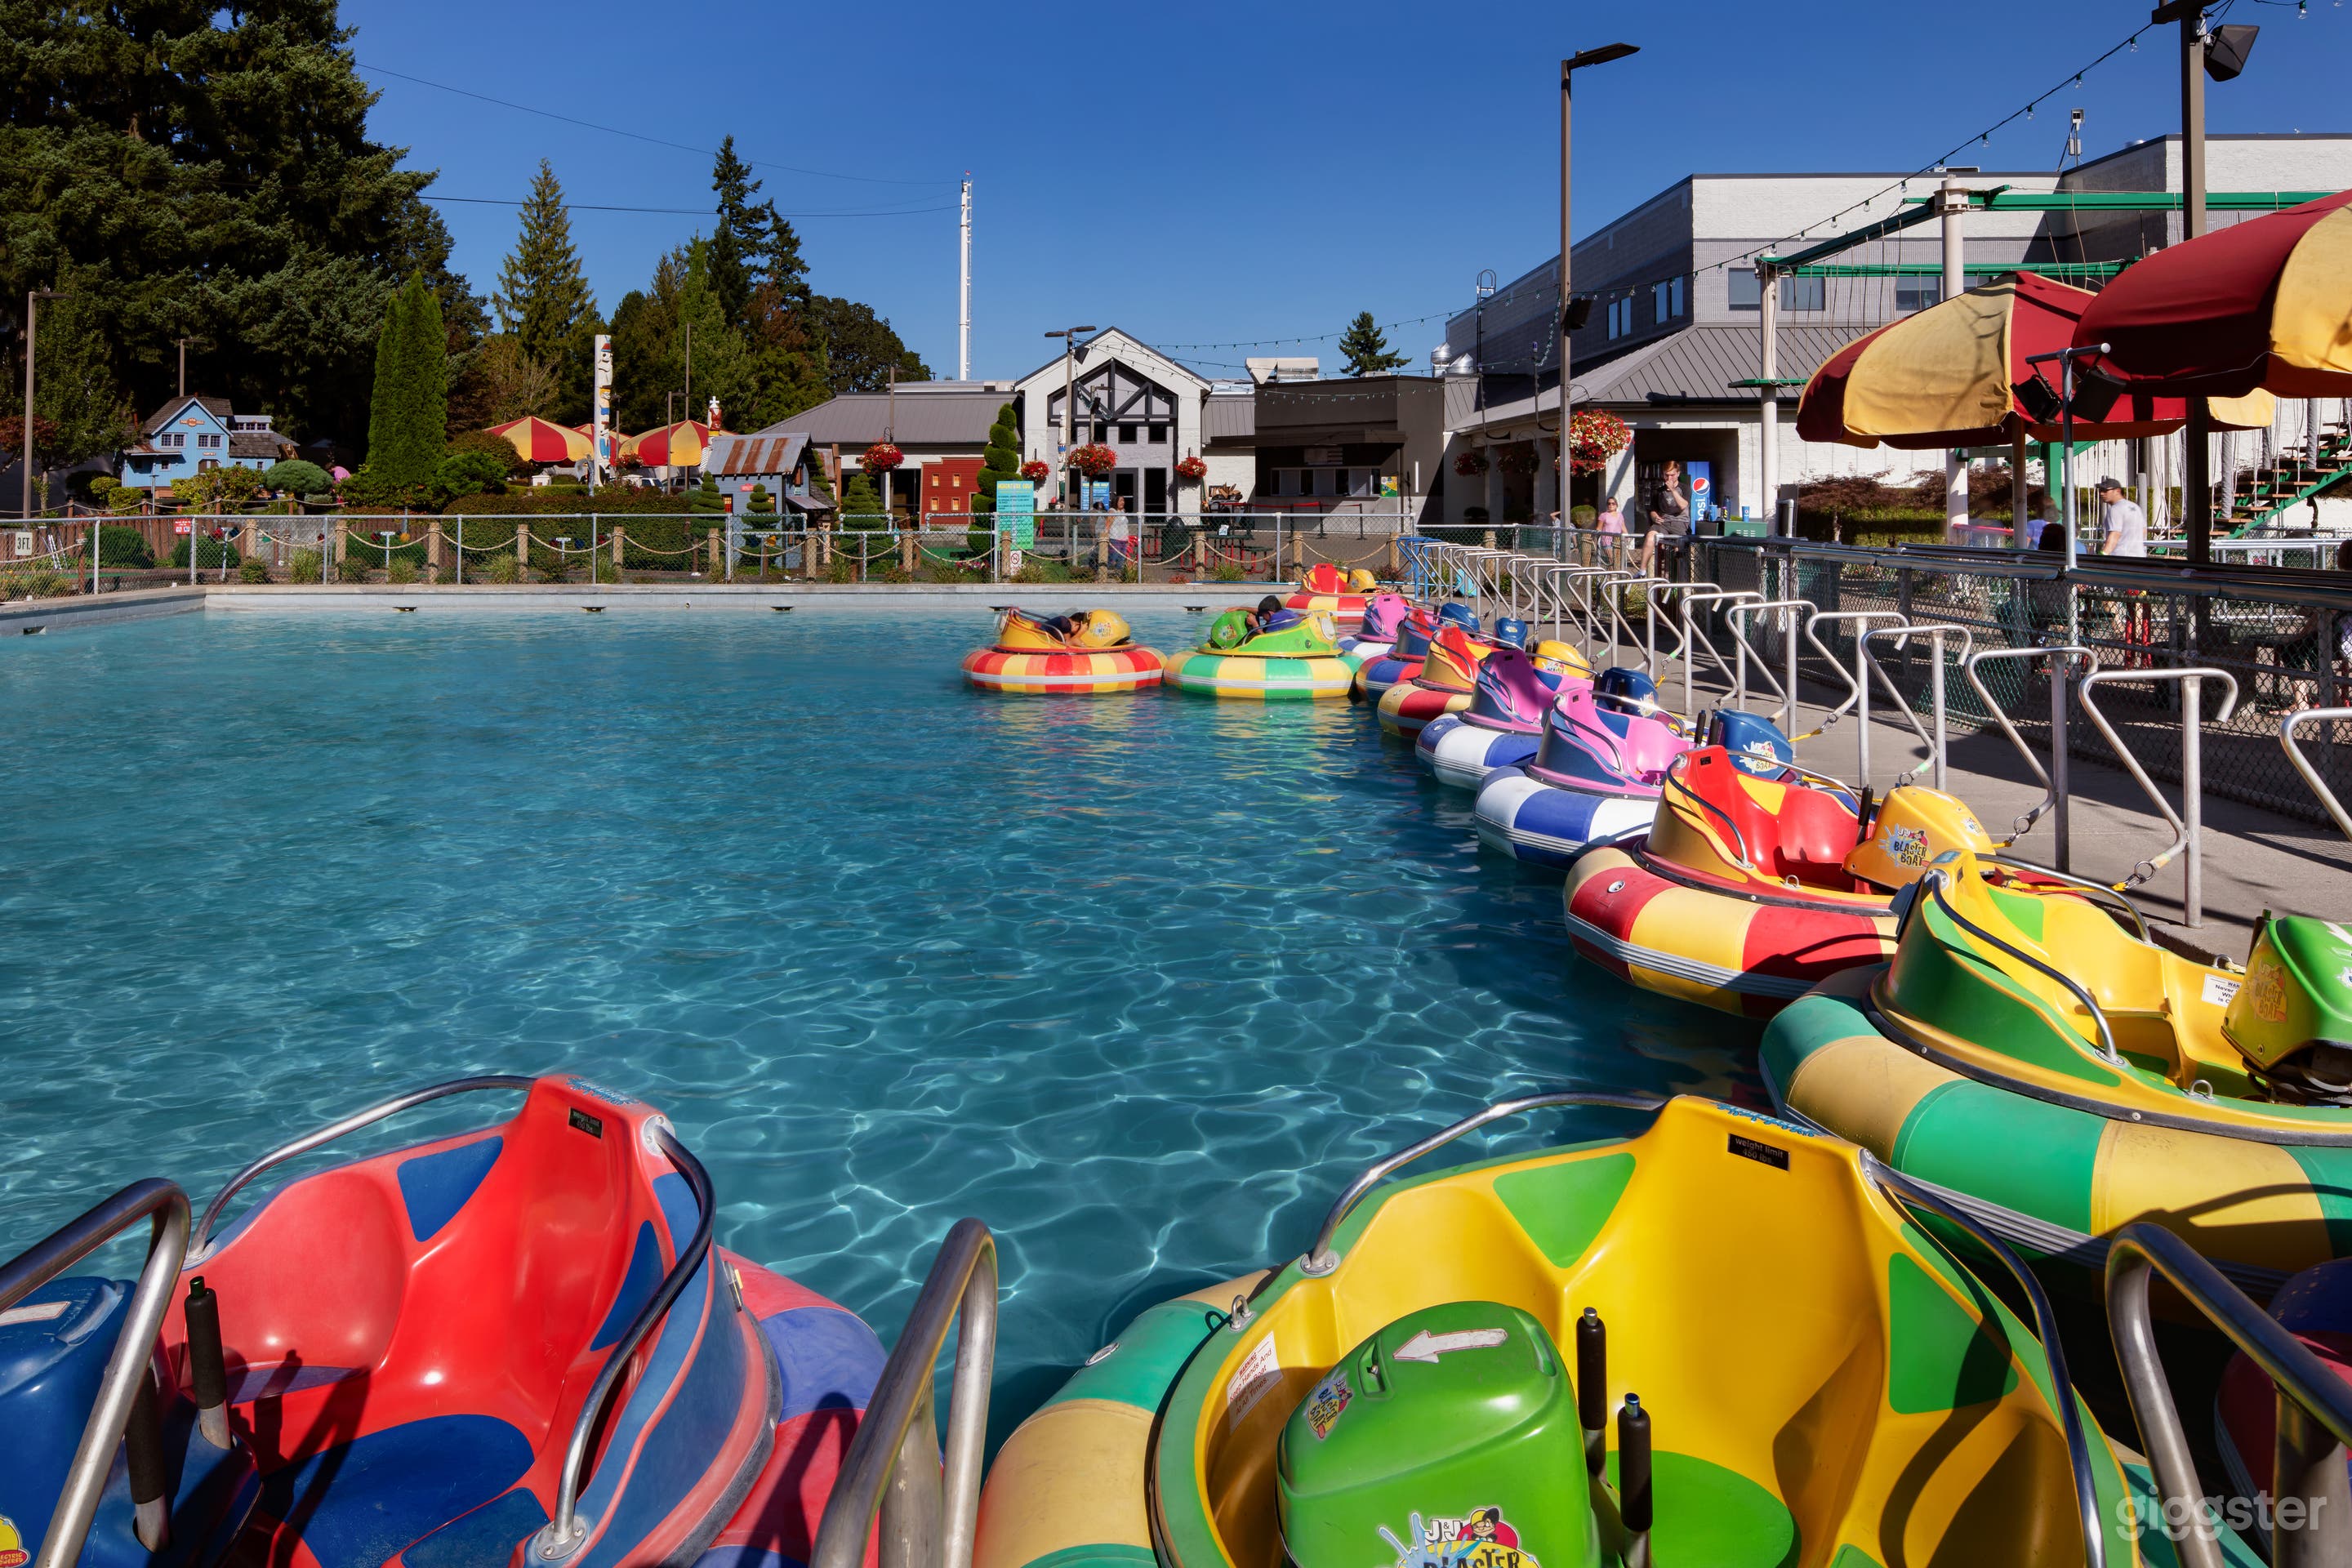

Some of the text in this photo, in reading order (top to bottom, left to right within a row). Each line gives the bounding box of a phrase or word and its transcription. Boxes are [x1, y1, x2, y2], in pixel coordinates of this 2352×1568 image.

[1894, 841, 1927, 857] BLASTER
[1900, 853, 1924, 866] BOAT
[1735, 1137, 1784, 1159] weight limit
[1743, 1148, 1757, 1160] 450
[1229, 1348, 1272, 1402] Keep Hands And
[1238, 1352, 1258, 1378] WARNING
[1253, 1365, 1267, 1382] Boat
[1235, 1404, 1242, 1415] At
[1242, 1396, 1250, 1408] All
[1318, 1388, 1338, 1423] BLASTER
[1424, 1520, 1463, 1542] J&J
